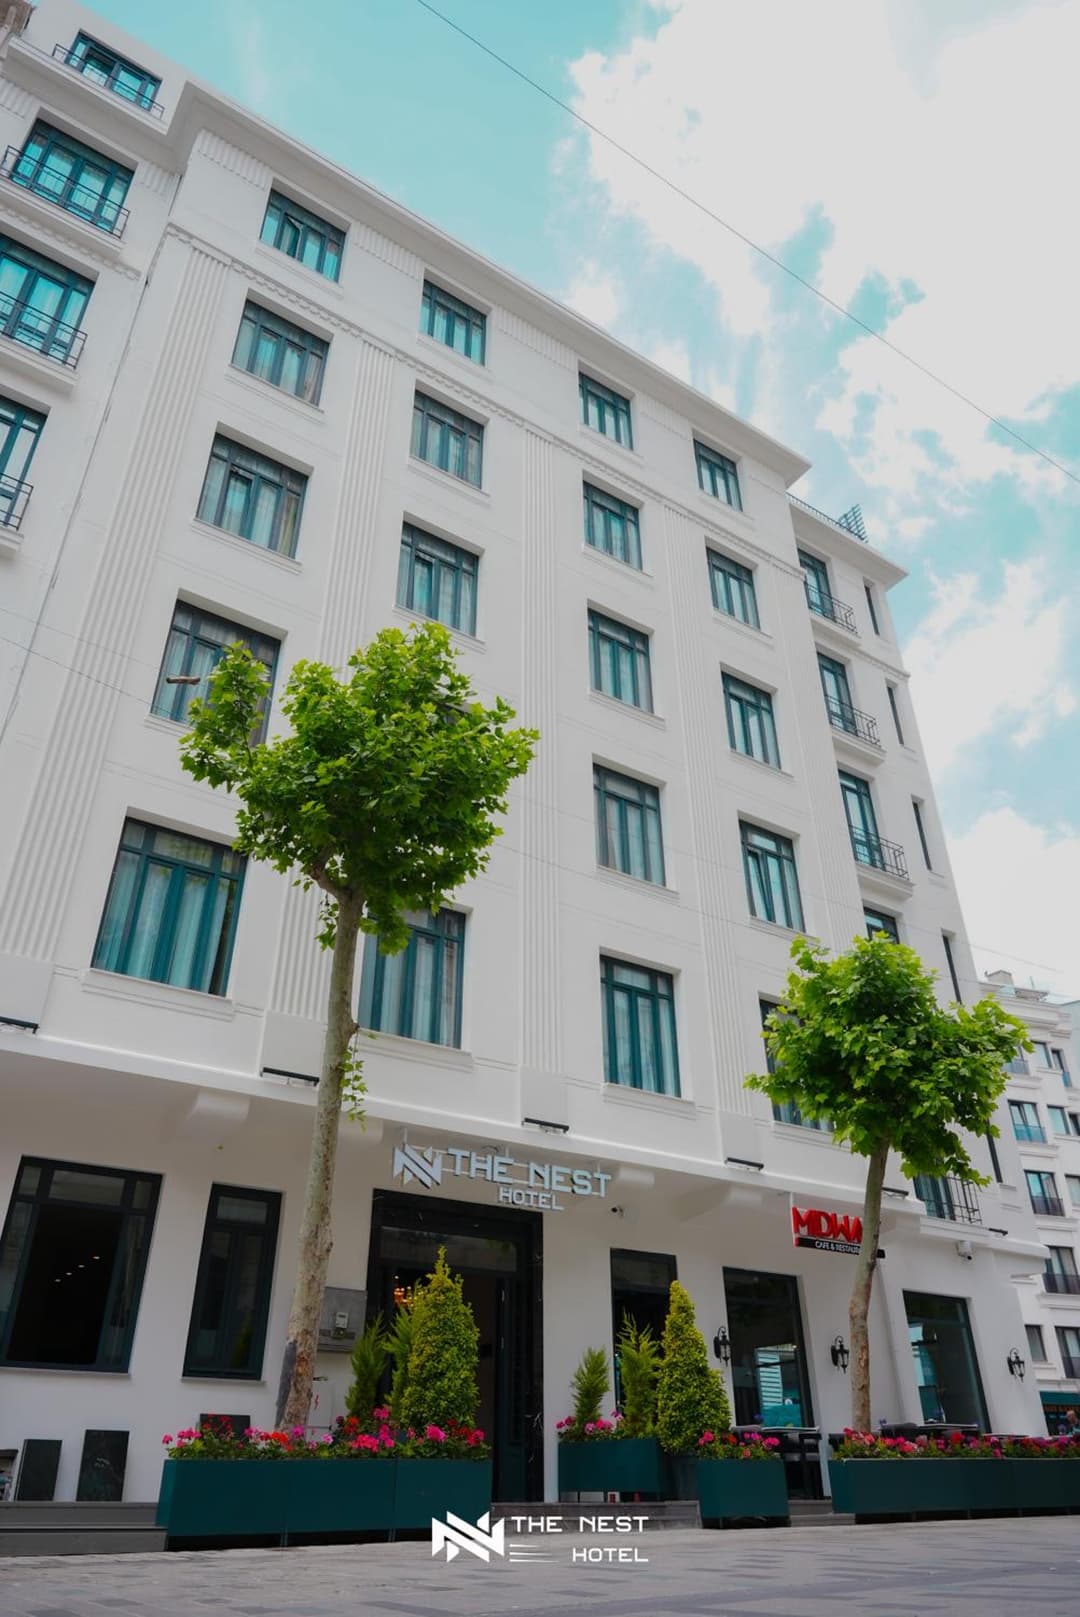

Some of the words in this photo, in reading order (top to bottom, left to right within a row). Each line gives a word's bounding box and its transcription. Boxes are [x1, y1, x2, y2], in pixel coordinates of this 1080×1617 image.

[447, 1148, 514, 1184] THE
[528, 1162, 612, 1197] NEST
[499, 1187, 565, 1211] HOTEL
[791, 1206, 863, 1244] MIDWA
